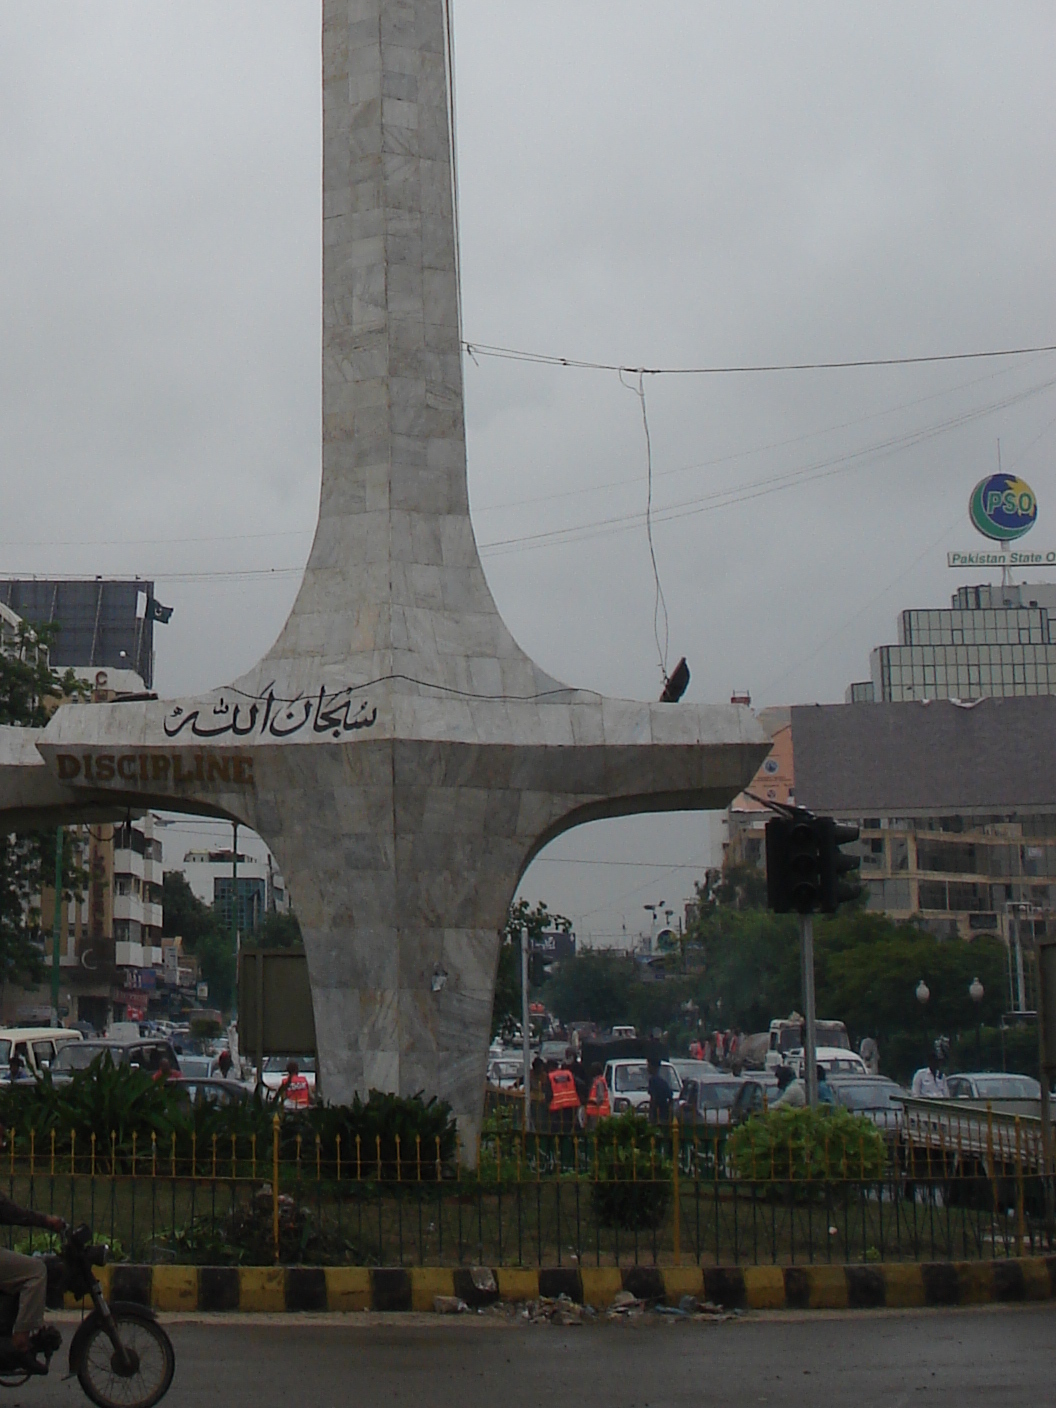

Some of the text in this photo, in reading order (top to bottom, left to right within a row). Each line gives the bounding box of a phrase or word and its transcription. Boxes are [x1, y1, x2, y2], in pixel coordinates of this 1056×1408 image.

[987, 491, 1033, 515] PSO
[952, 553, 1006, 564] Pakistan
[1010, 552, 1042, 563] State
[56, 753, 254, 784] DISCIPLINE
